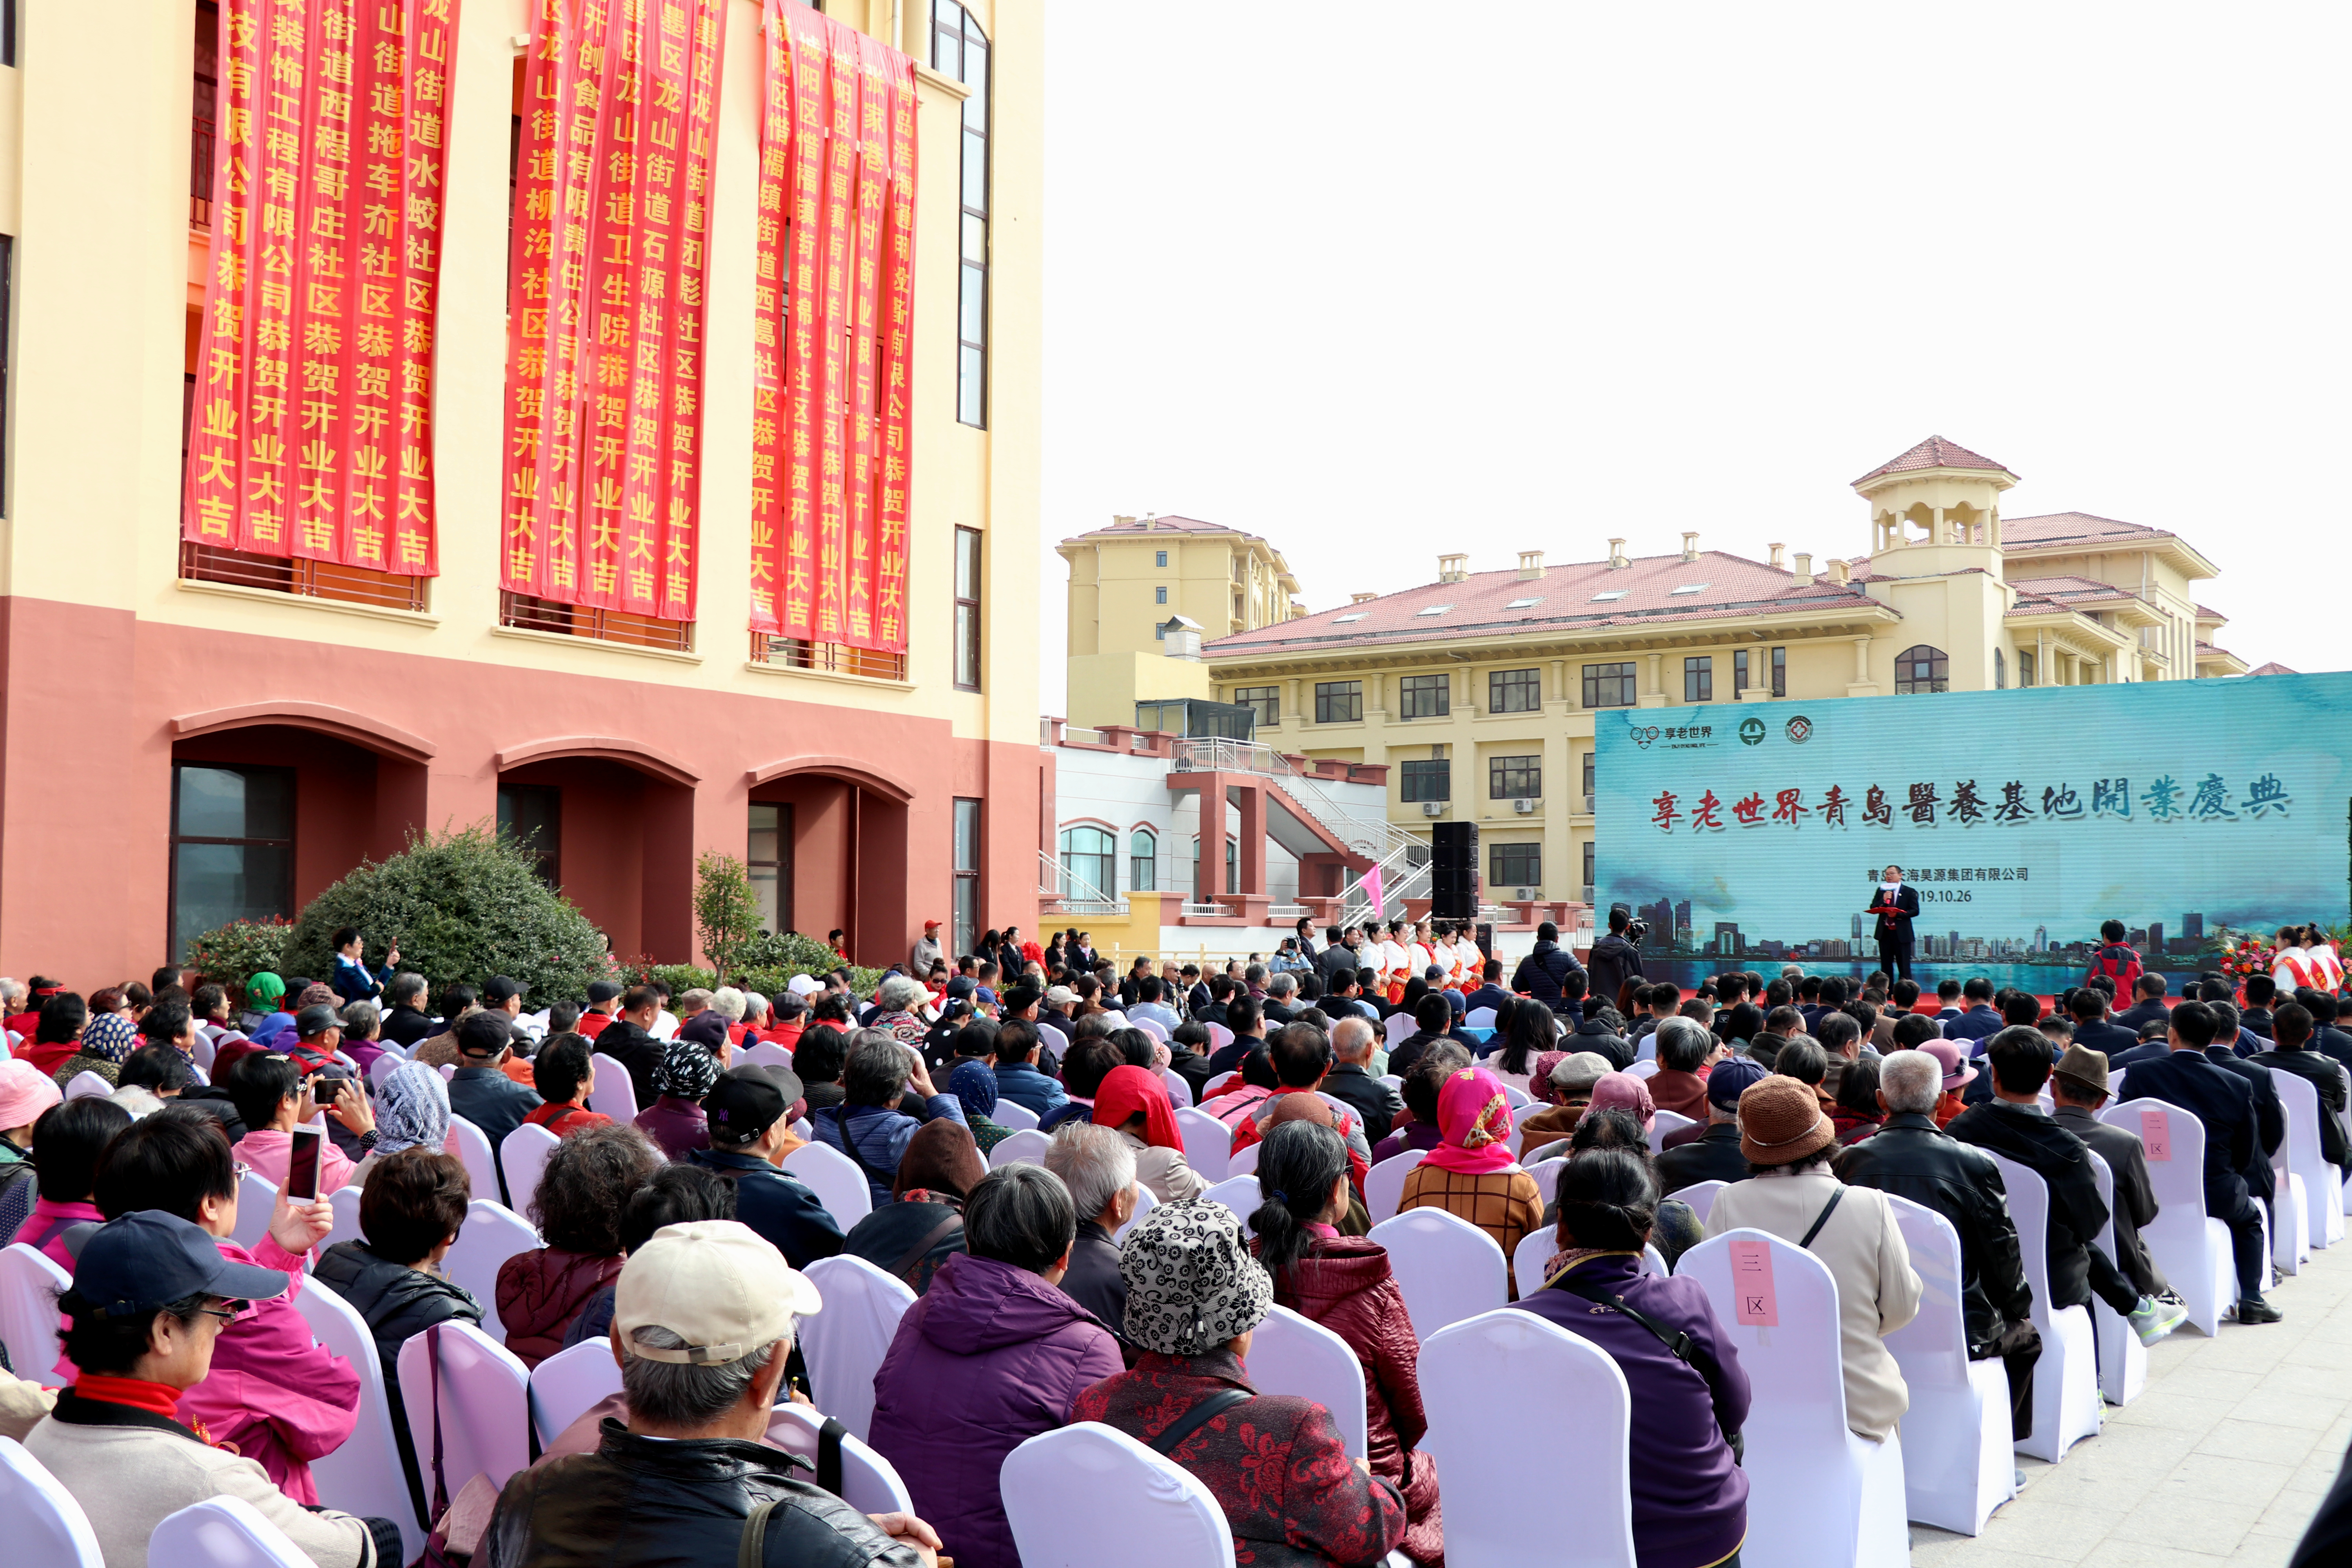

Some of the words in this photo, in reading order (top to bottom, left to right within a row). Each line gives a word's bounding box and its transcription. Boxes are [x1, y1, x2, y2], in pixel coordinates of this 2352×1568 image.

[197, 0, 258, 538] 技有限公司恭贺开业大吉
[299, 0, 357, 552] 街道西程哥庄社区恭贺开业大吉
[550, 0, 607, 588] 开创食品有限责任公司恭贺开业大吉
[629, 0, 686, 601] 墨区龙山街道石源社区恭贺开业大吉
[1664, 726, 1712, 740] 享老世界
[1651, 773, 2290, 829] 享老世界青島醫養基地開業慶典
[1920, 890, 1972, 902] 19.10.26
[2149, 1120, 2163, 1154] 二区
[1742, 1254, 1766, 1315] 三区
